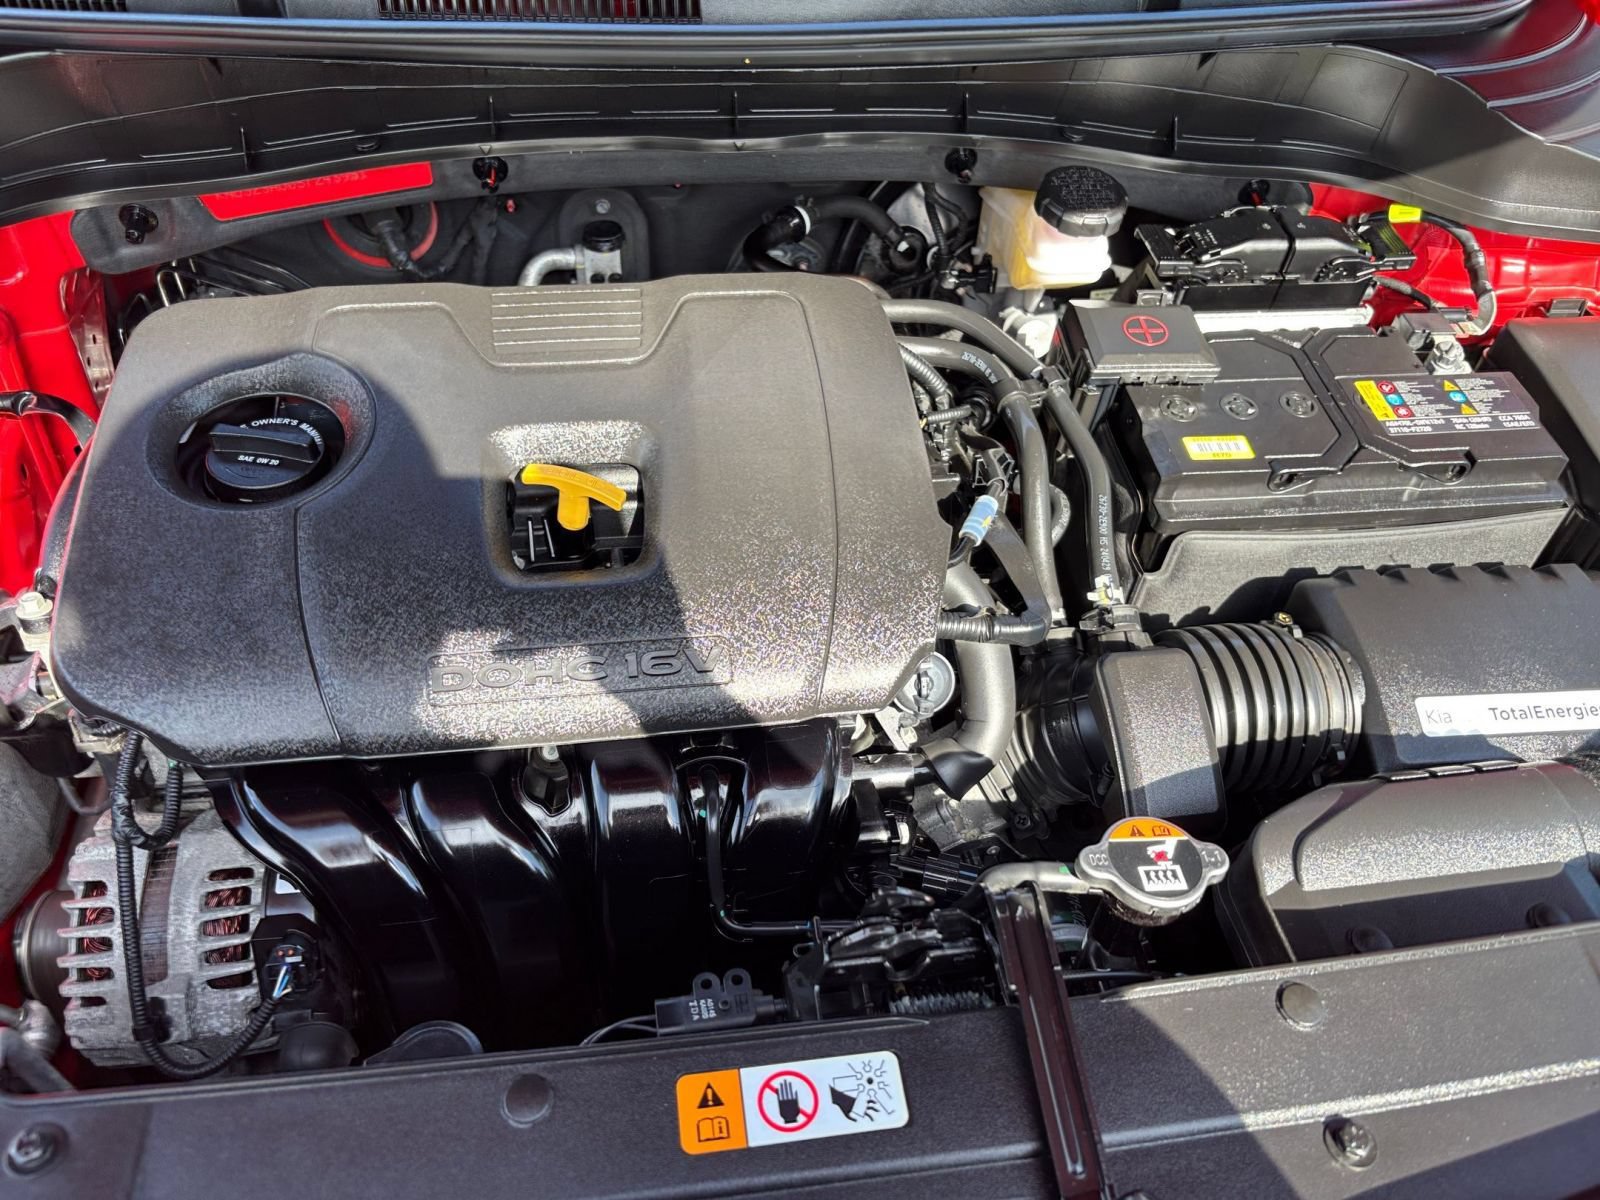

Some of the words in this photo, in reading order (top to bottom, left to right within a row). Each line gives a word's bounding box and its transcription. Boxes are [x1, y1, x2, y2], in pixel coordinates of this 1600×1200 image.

[251, 417, 299, 427] OWNER'S
[431, 655, 608, 693] DOHC
[625, 645, 723, 679] 16V
[1425, 709, 1453, 725] Kia
[1488, 702, 1600, 721] TotalEnergie
[1088, 853, 1109, 866] DCC
[688, 1000, 700, 1021] TDA
